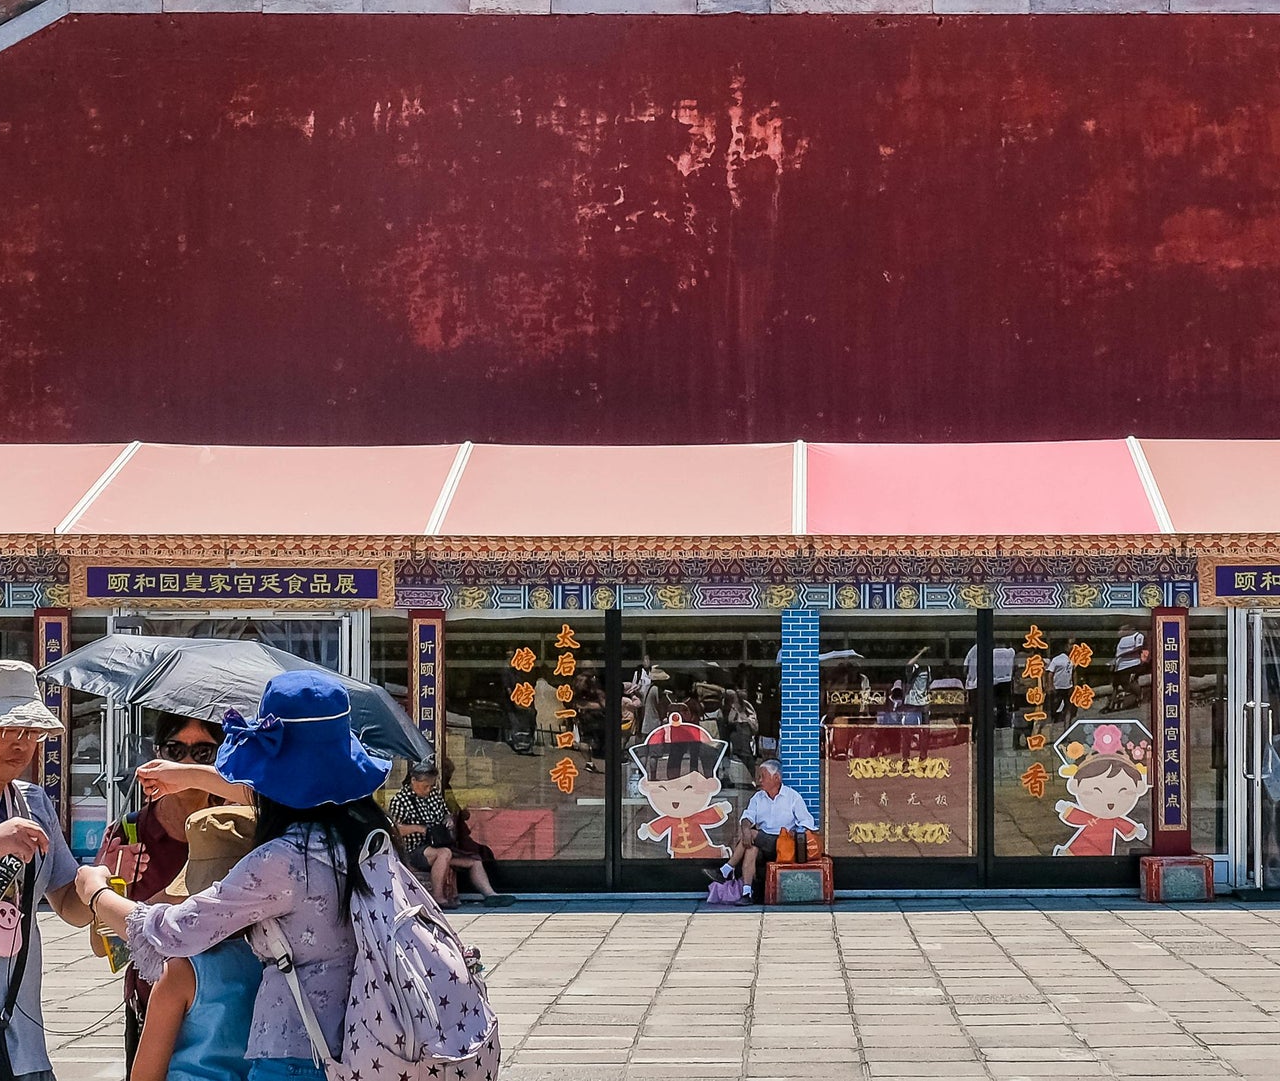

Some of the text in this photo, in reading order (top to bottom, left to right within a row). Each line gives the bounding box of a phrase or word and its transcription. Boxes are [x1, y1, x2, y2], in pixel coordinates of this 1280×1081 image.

[107, 572, 359, 594] 颐和园皇家宫廷食品展
[420, 640, 435, 764] 听颐和园皇
[511, 647, 536, 708] 饽饽
[550, 624, 580, 793] 太后的一口香
[1021, 625, 1049, 798] 太后的一口香
[1070, 643, 1095, 709] 饽饽
[1164, 637, 1180, 808] 品颐和园宫廷糕点
